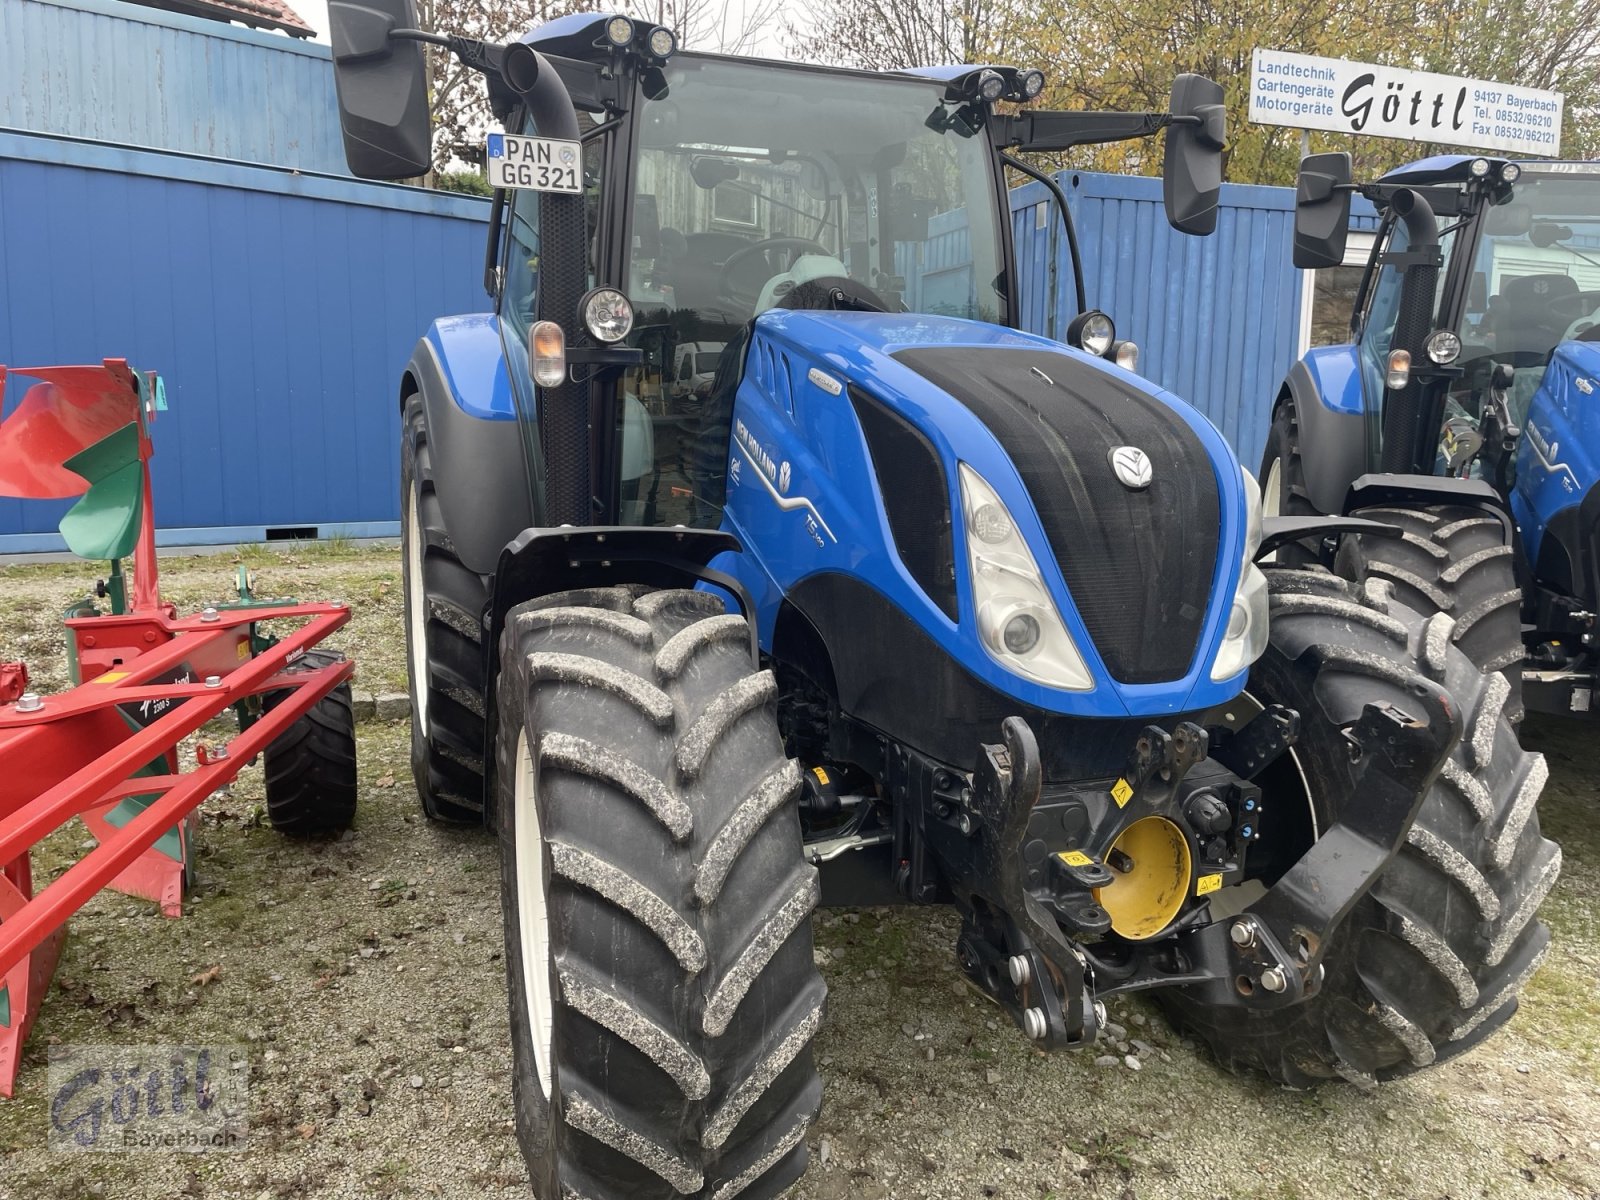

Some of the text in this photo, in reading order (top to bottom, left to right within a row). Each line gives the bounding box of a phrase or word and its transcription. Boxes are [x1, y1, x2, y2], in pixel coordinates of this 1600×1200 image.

[1258, 59, 1336, 81] Landtechnik
[1257, 77, 1335, 99] Gartengeräte
[1255, 95, 1334, 116] Motorgeräte
[1341, 73, 1467, 131] Göttl
[1474, 90, 1558, 113] 94137 Bayerbach
[1473, 105, 1553, 128] Tel. 08532/96210
[1472, 121, 1556, 144] Fax 08532/962121
[493, 148, 501, 157] D
[506, 139, 551, 164] PAN
[502, 163, 579, 190] GG 321
[748, 433, 777, 483] HOLLAND
